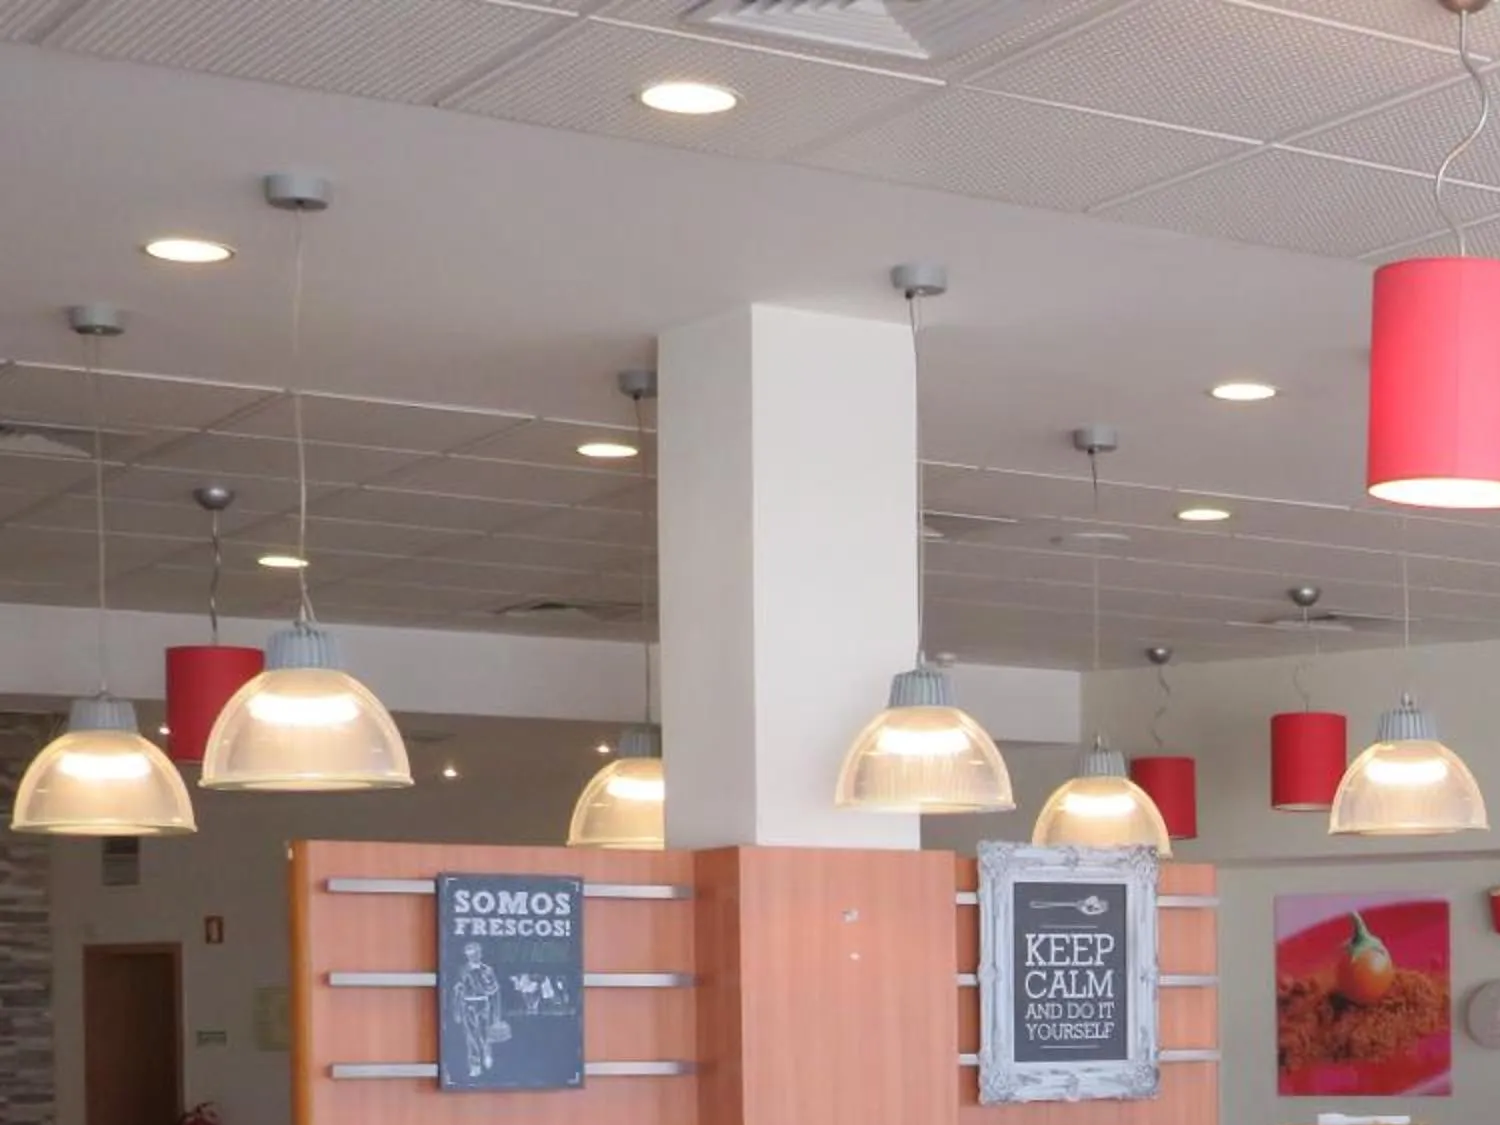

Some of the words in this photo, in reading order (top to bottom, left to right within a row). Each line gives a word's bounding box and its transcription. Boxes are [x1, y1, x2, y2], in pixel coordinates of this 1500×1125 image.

[454, 889, 571, 915] SOMOS
[454, 917, 571, 937] FRESCOS!
[1025, 933, 1115, 966] KEEP
[1025, 969, 1114, 999] CALM
[1025, 1003, 1063, 1019] AND
[1067, 1002, 1094, 1019] DO
[1099, 1002, 1115, 1019] IT
[1025, 1022, 1115, 1040] YOURSELF
